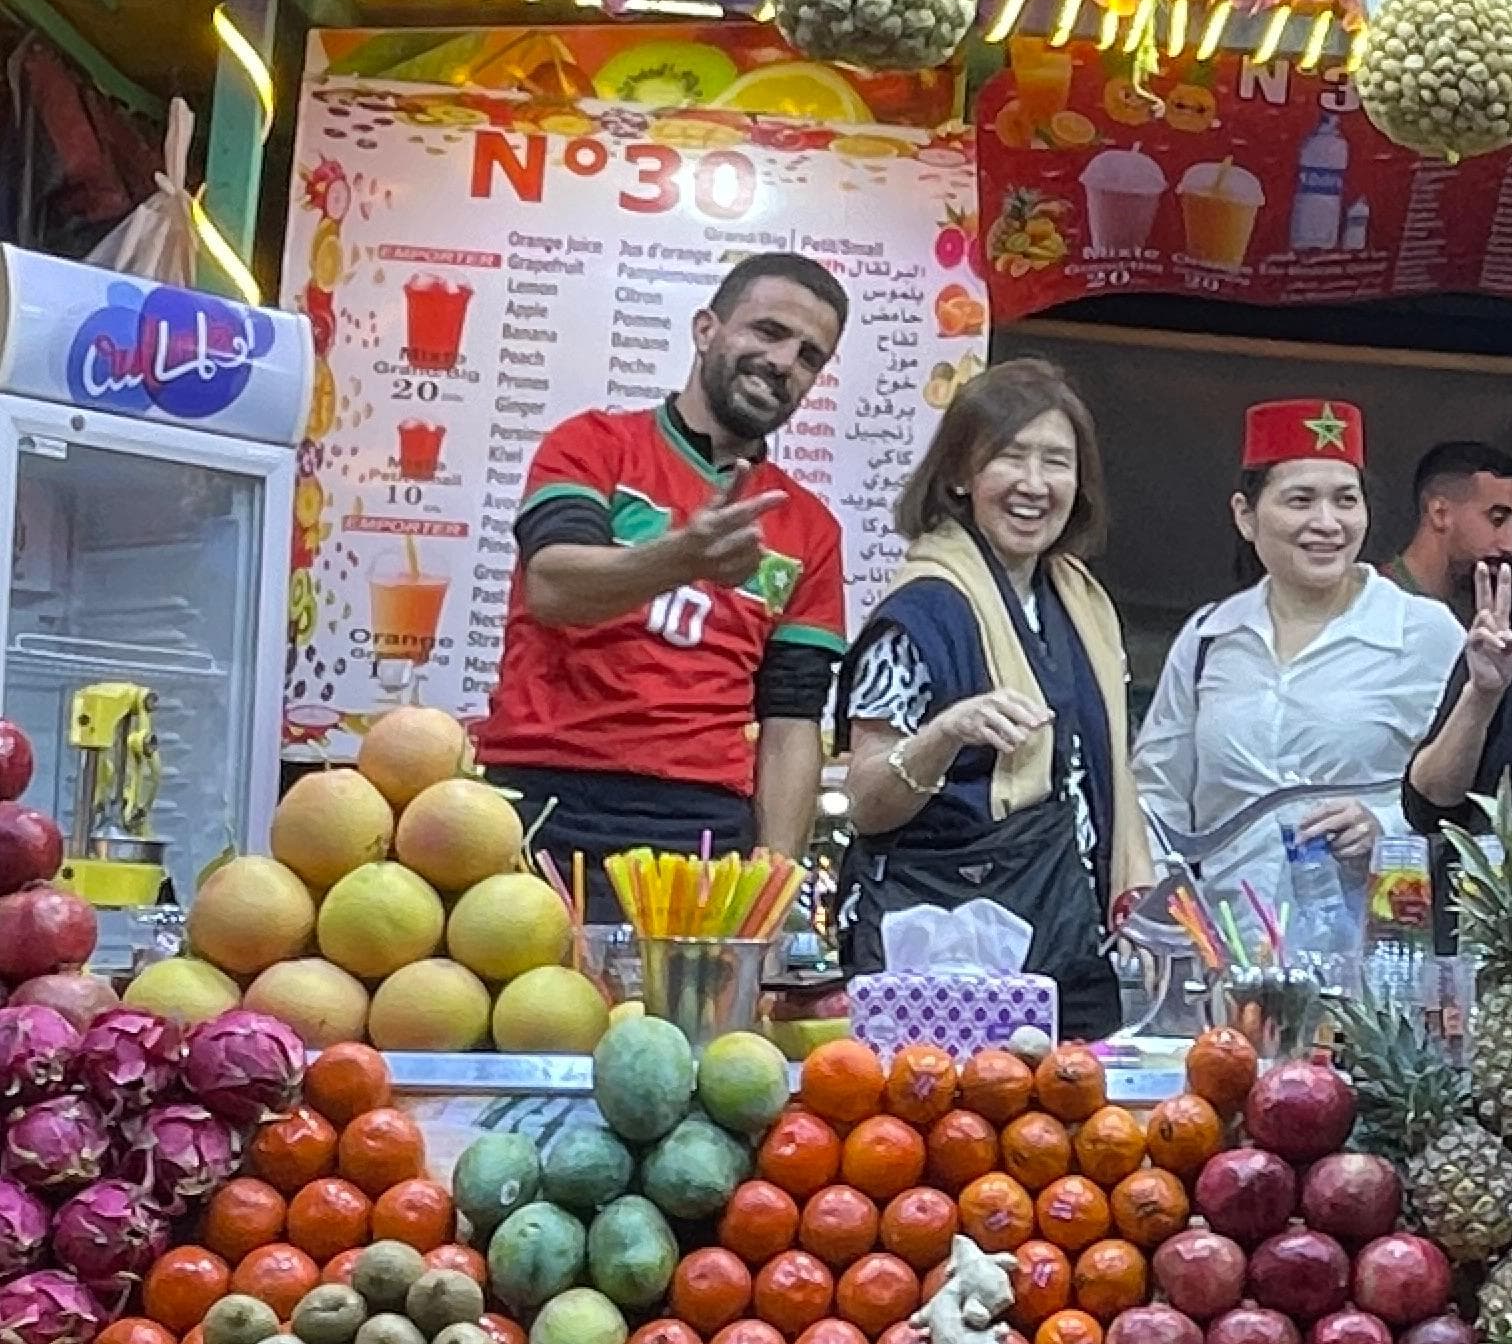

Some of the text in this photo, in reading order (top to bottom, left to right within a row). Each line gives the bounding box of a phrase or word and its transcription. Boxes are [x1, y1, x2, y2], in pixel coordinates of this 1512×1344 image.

[508, 230, 562, 253] Orange
[508, 252, 584, 275] Grapefruit
[507, 277, 558, 296] Lemon
[615, 286, 663, 305] Citron
[505, 299, 548, 319] Apple
[502, 322, 557, 343] Banana
[390, 378, 439, 401] 20
[387, 485, 422, 505] 10
[647, 585, 712, 647] 10
